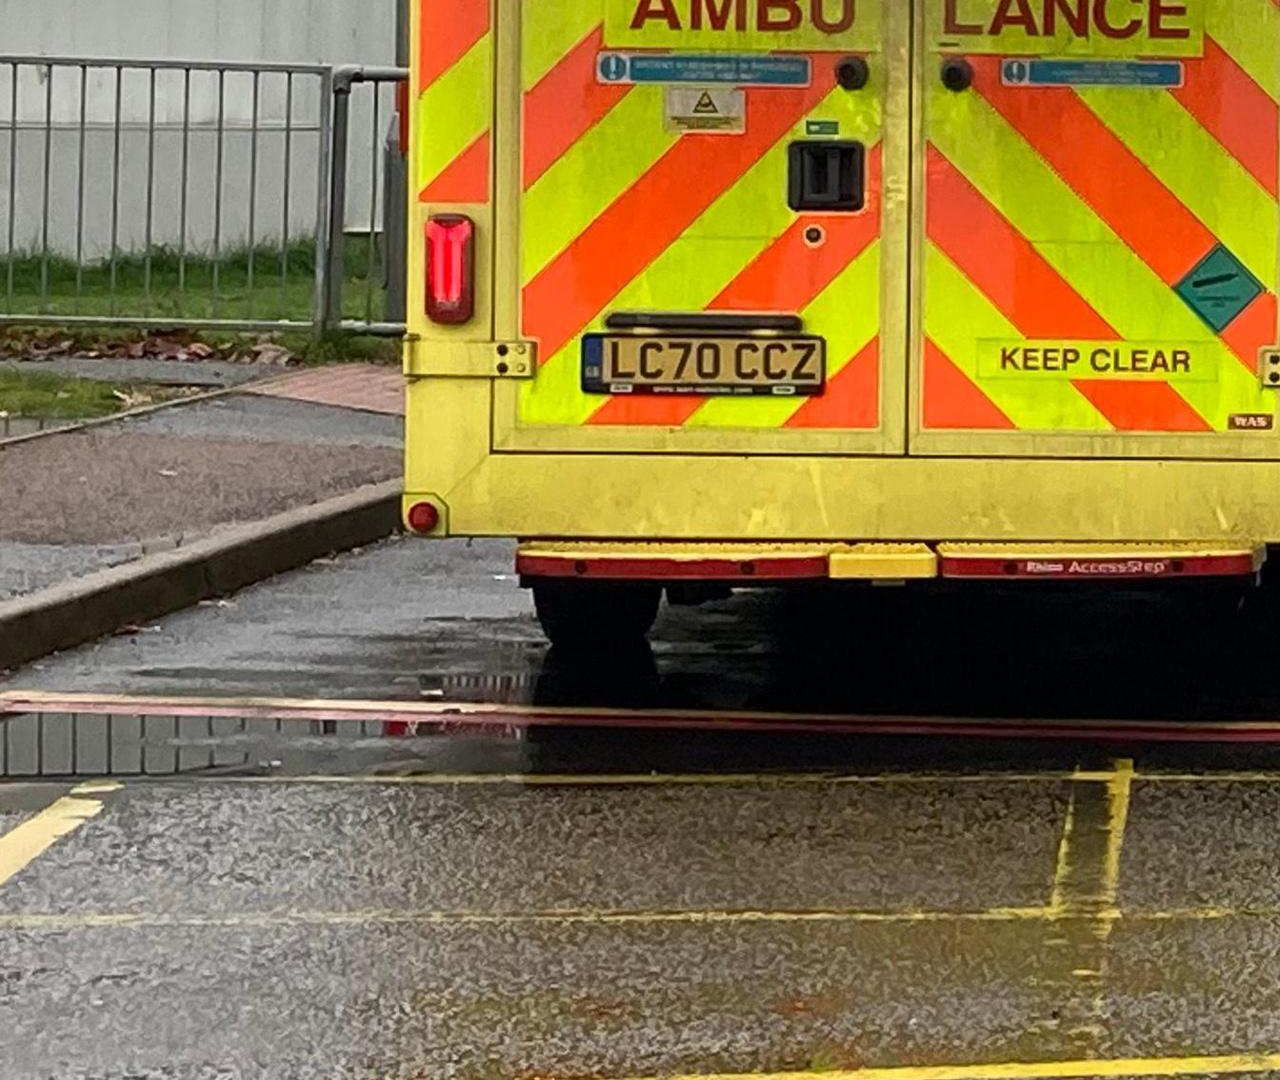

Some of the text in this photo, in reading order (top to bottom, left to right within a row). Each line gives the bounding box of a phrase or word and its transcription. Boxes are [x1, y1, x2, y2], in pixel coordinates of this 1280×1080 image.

[610, 341, 816, 380] LC70 CCZ
[1000, 348, 1191, 373] KEEP CLEAR
[1233, 416, 1267, 427] WAS
